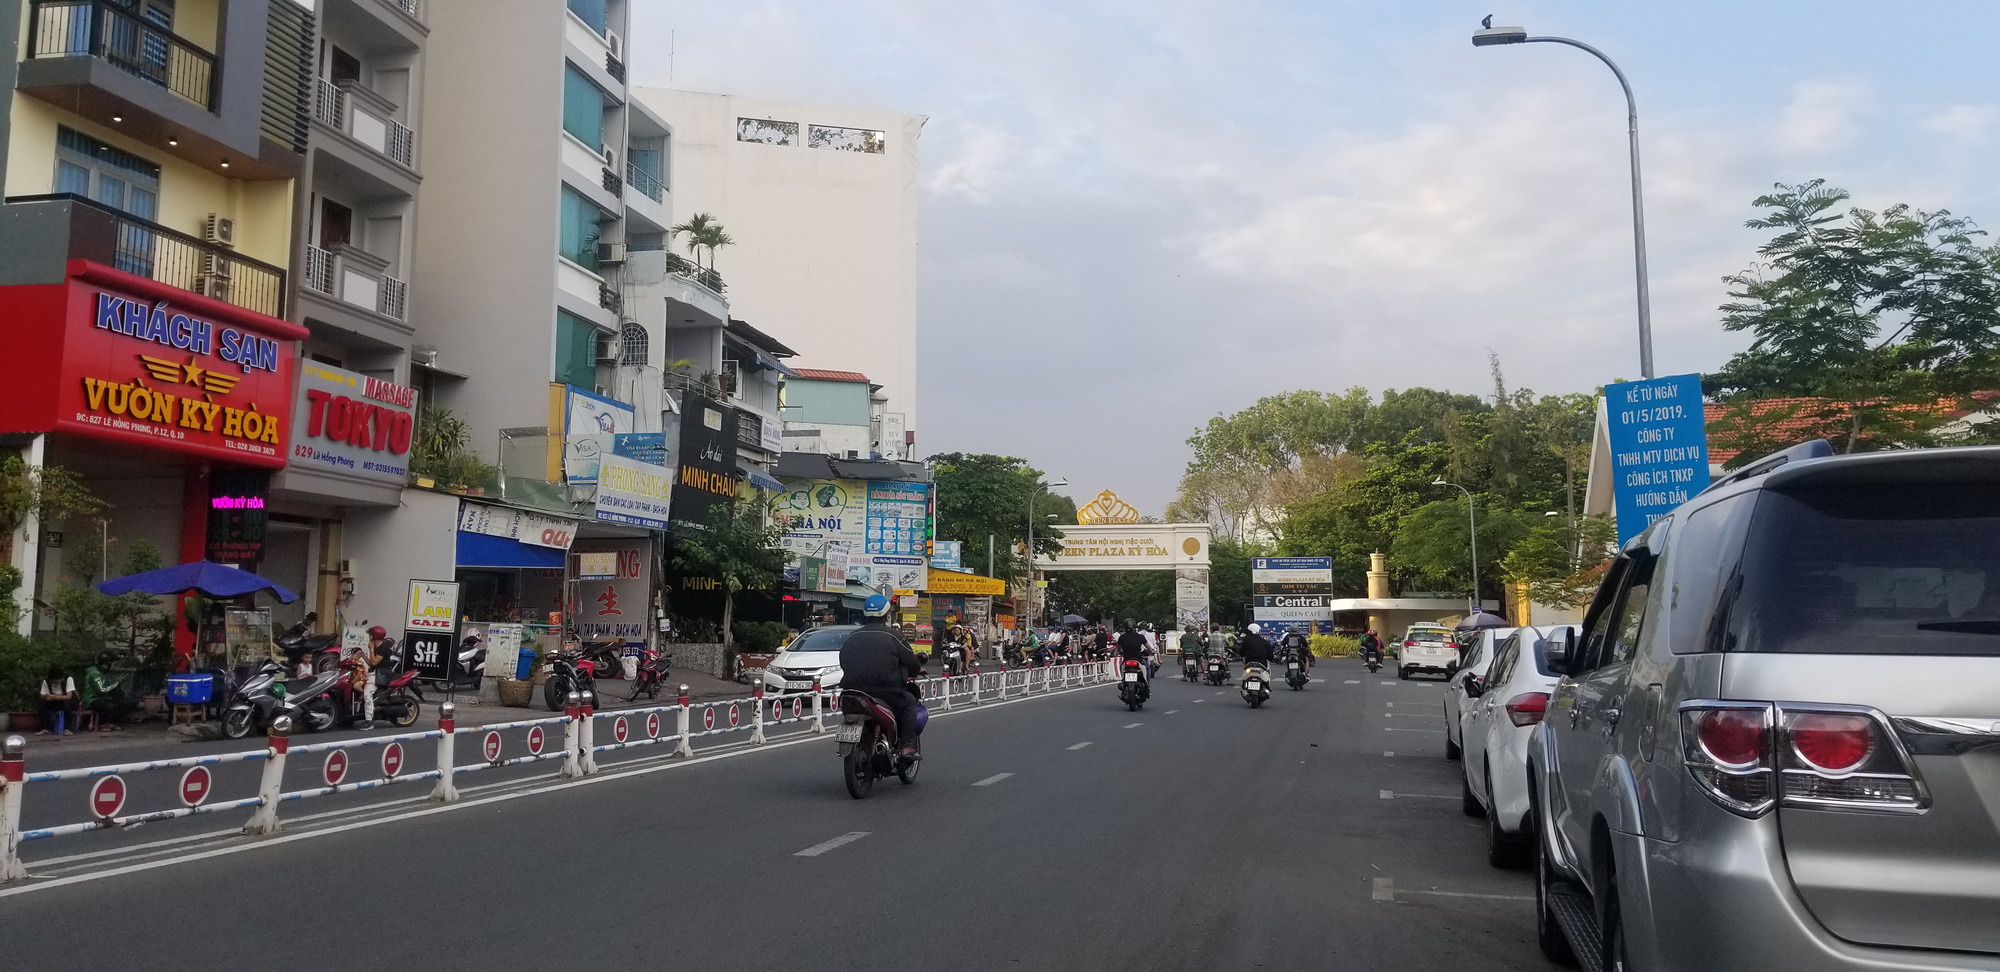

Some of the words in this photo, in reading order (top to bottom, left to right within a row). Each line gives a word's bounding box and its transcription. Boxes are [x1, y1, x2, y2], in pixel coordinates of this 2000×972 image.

[97, 292, 212, 355] KHÁCH
[219, 328, 279, 373] SẠN
[362, 376, 415, 408] MASSAGE
[1626, 385, 1639, 403] KỂ
[1640, 385, 1653, 402] TỪ
[1655, 382, 1678, 400] NGÀY
[84, 376, 175, 424] VƯỜN
[179, 394, 220, 432] KỲ
[222, 402, 279, 444] HÒA
[89, 415, 102, 425] 827
[103, 416, 112, 427] LÊ
[307, 389, 413, 455] TOKYO
[1637, 428, 1662, 444] CÔNG
[1663, 427, 1674, 441] TY
[295, 444, 313, 459] 829
[313, 451, 320, 460] Lê
[337, 455, 355, 468] Phong
[1617, 452, 1641, 466] TNHH
[1643, 450, 1663, 464] MTV
[1664, 448, 1685, 465] DỊCH
[1687, 446, 1700, 462] VỤ
[610, 465, 640, 495] PHONG
[640, 471, 662, 498] SANG
[682, 465, 708, 491] MINH
[710, 472, 735, 497] CHÂU
[1627, 471, 1650, 487] CÔNG
[1652, 468, 1668, 484] ÍCH
[1669, 468, 1694, 483] TNXP
[1636, 489, 1667, 507] HƯỚNG
[1668, 486, 1688, 505] DẪN
[818, 514, 841, 532] NỘI
[1057, 547, 1086, 557] UEEN
[1089, 547, 1125, 557] PLAZA
[1127, 545, 1143, 556] KỲ
[1146, 545, 1169, 556] HÒA
[596, 584, 623, 616] 生
[1263, 596, 1272, 607] F
[1276, 596, 1322, 606] Central
[411, 619, 450, 628] CAFE
[413, 640, 440, 664] SH
